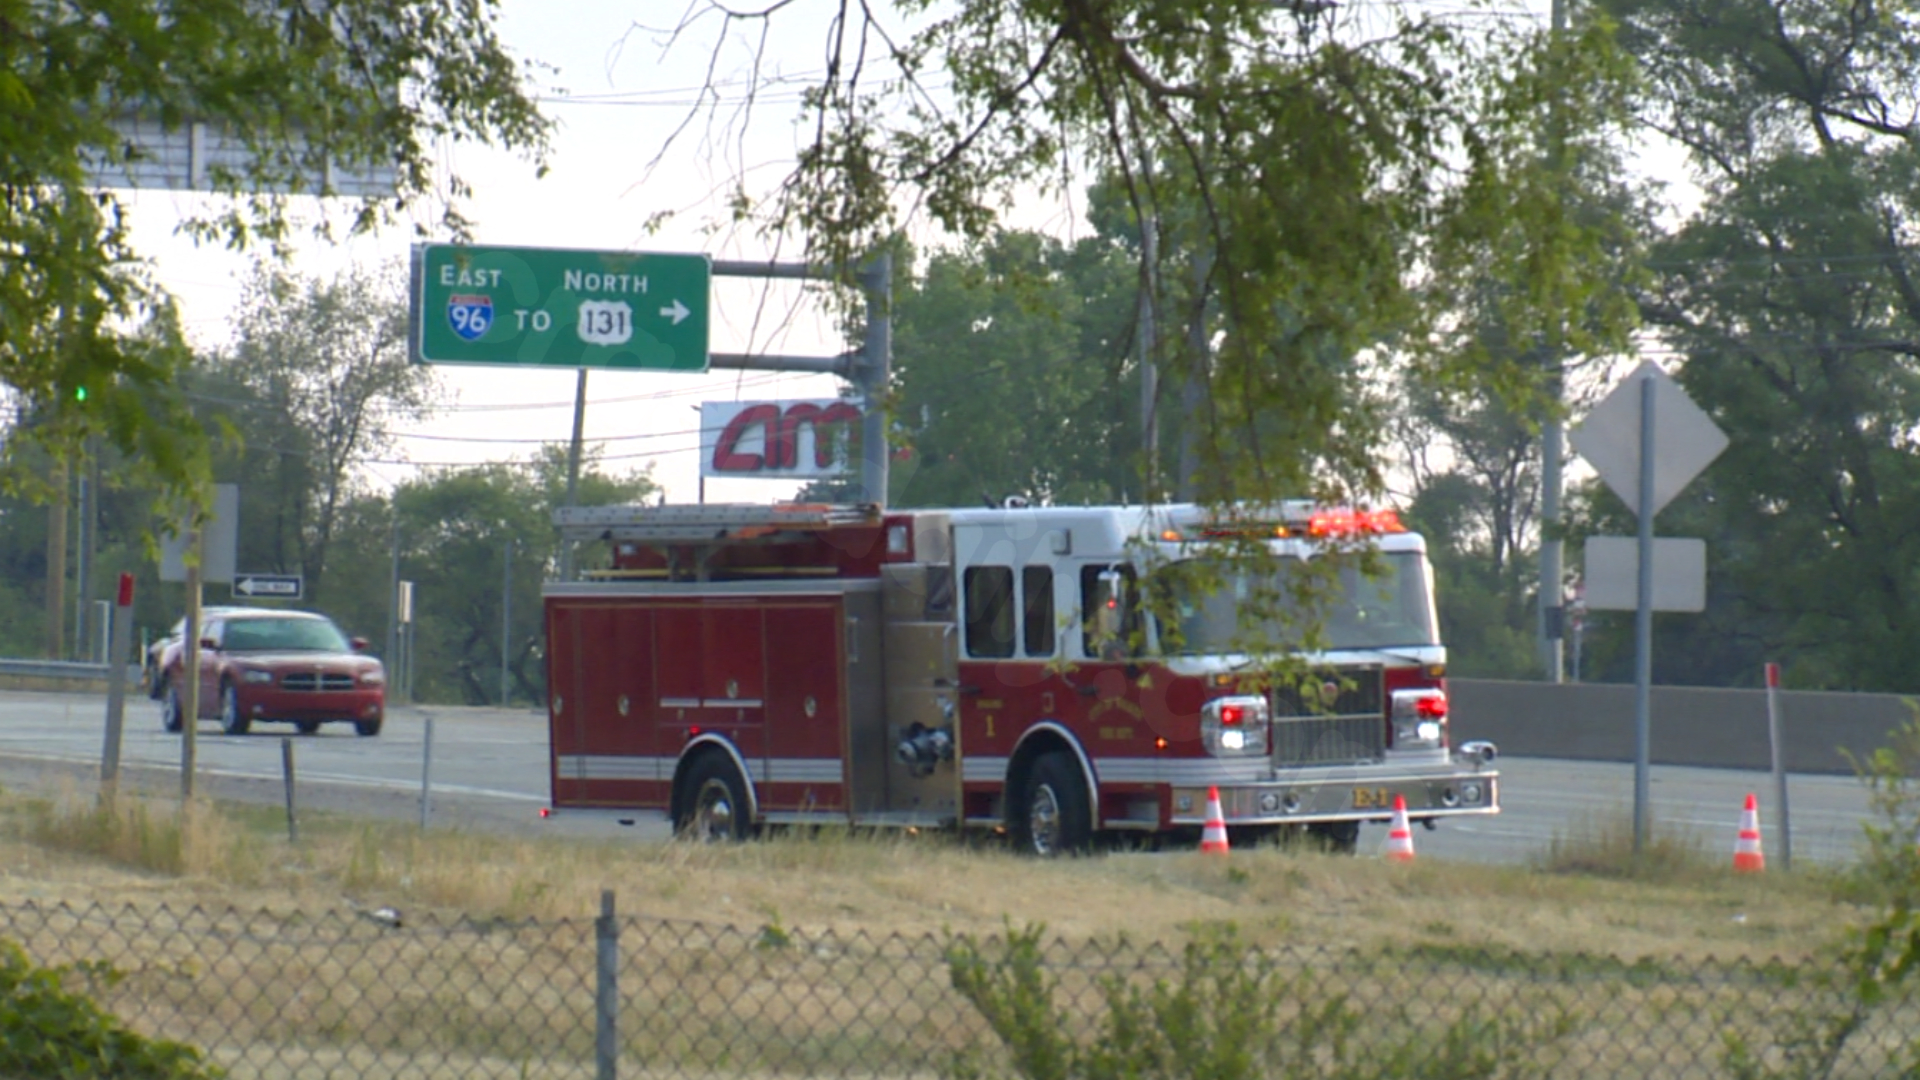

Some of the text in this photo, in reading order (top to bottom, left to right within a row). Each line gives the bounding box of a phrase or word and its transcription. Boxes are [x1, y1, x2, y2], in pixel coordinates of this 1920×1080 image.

[440, 264, 502, 288] EAST
[563, 269, 648, 293] NORTH
[451, 306, 625, 335] 96 TO 131
[1354, 786, 1388, 808] E-1
